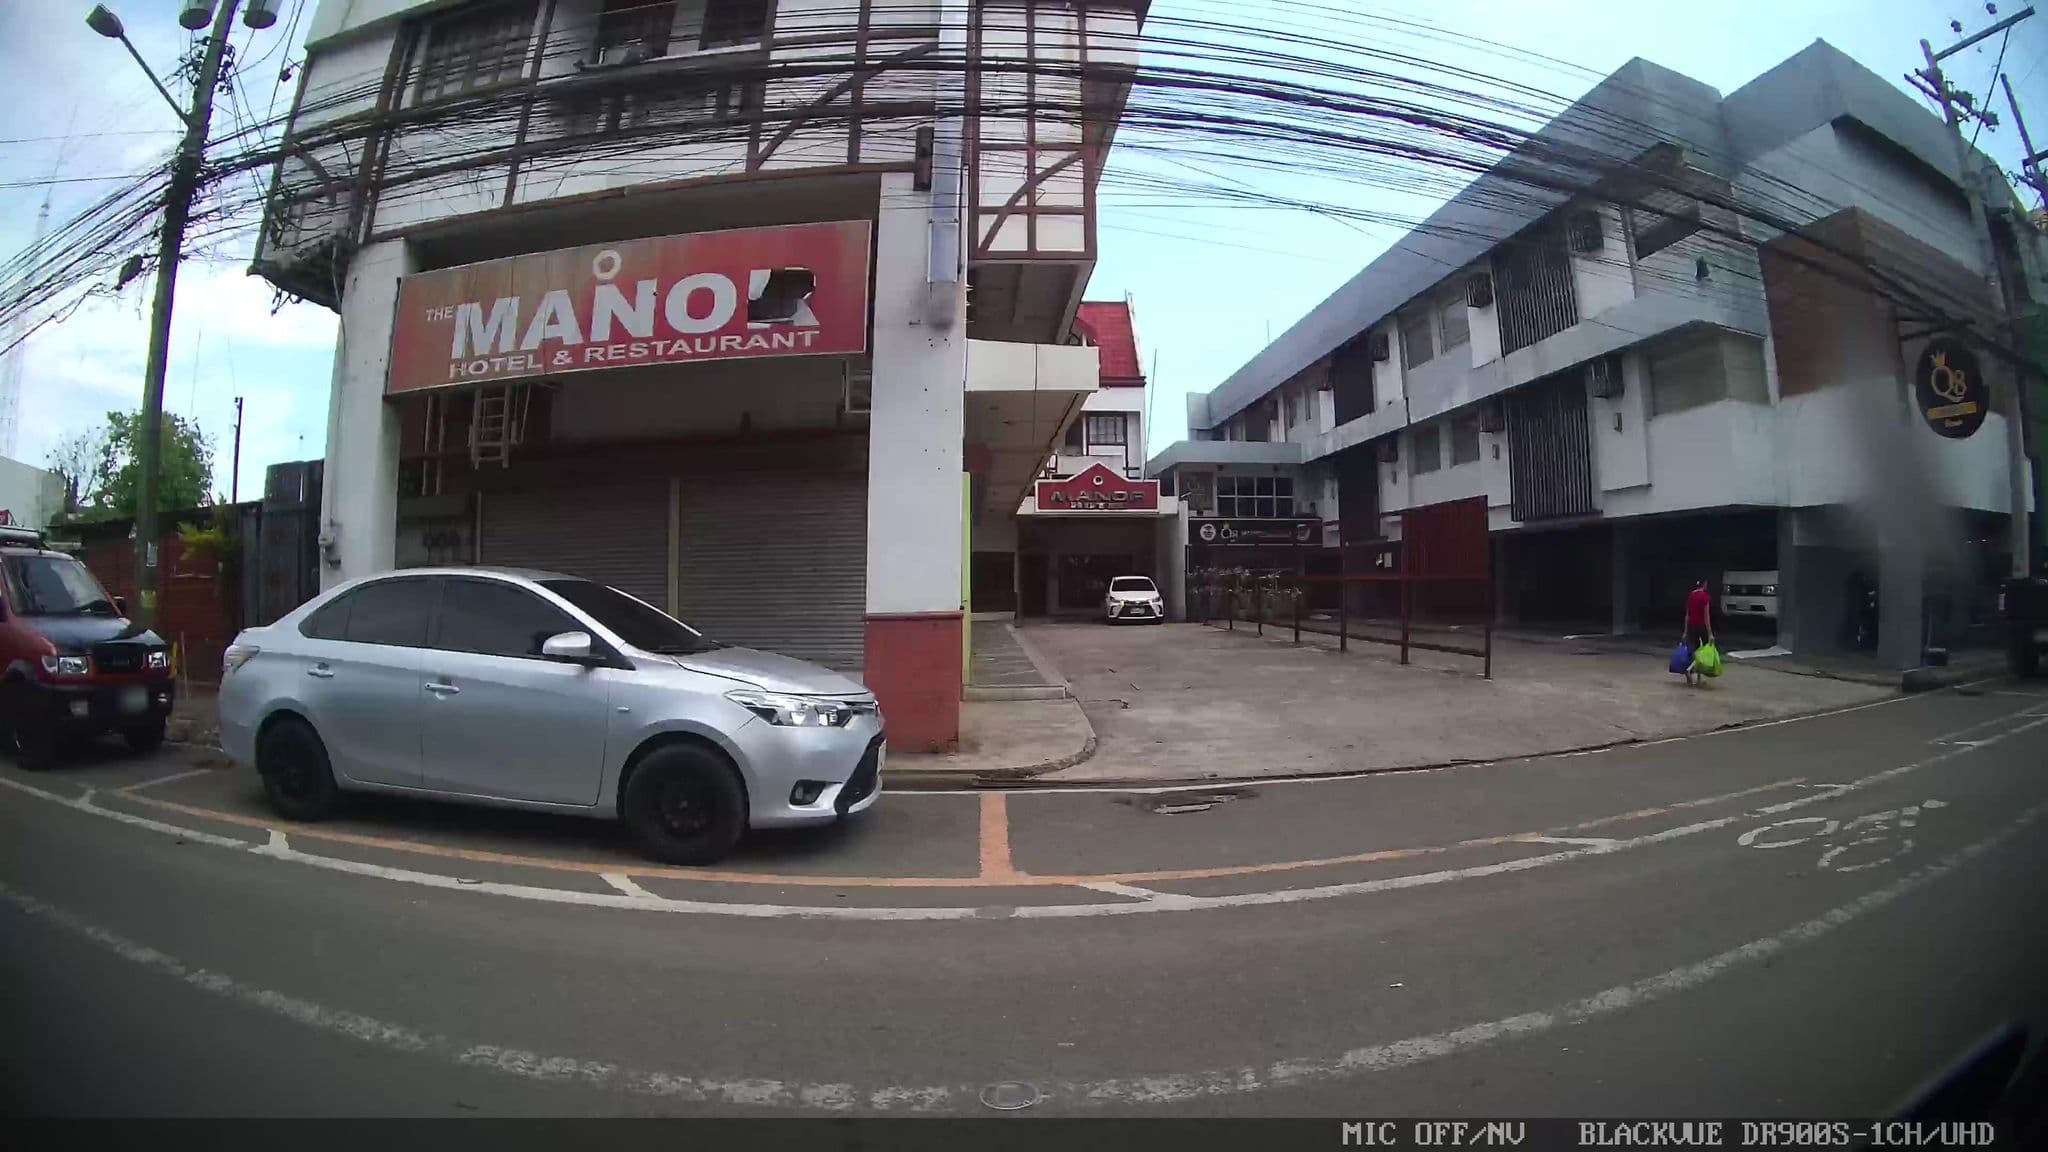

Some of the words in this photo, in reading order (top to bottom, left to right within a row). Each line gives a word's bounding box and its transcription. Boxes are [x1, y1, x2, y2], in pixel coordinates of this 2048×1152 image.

[426, 305, 453, 321] THE
[450, 353, 543, 378] HOTEL
[551, 350, 574, 366] &
[584, 330, 820, 363] RESTAURANT
